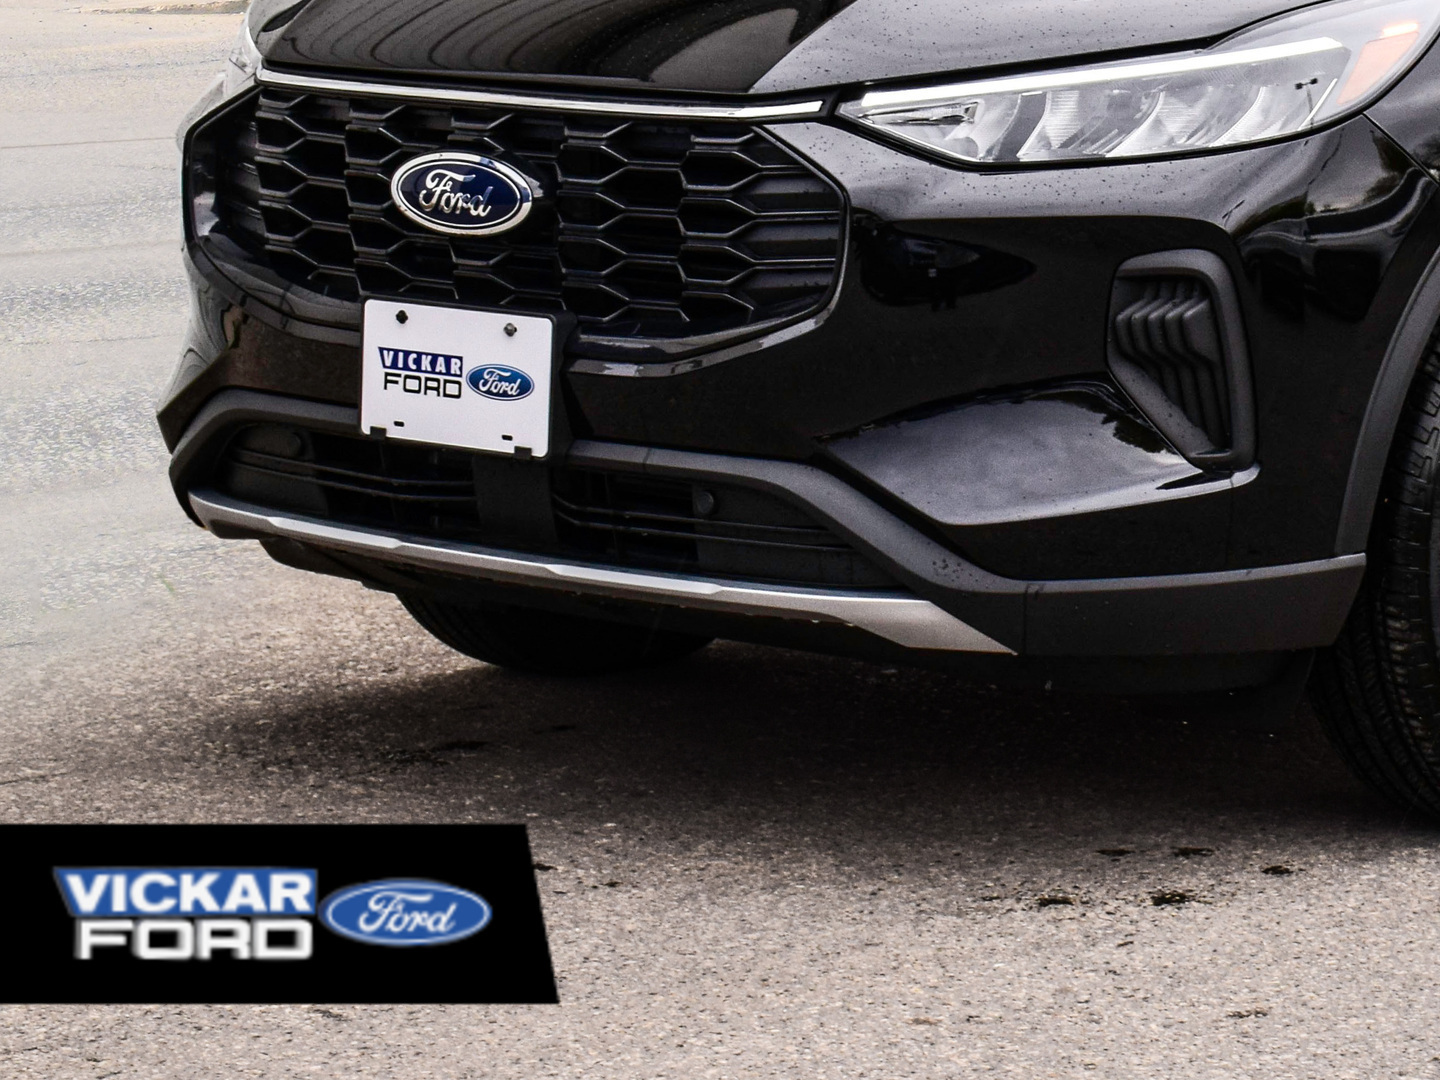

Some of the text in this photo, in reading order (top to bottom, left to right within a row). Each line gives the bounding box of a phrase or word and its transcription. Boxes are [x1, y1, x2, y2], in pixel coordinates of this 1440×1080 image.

[418, 167, 494, 218] Ford
[381, 348, 463, 377] VICKAR
[383, 371, 463, 400] FORD
[478, 368, 520, 397] Ford
